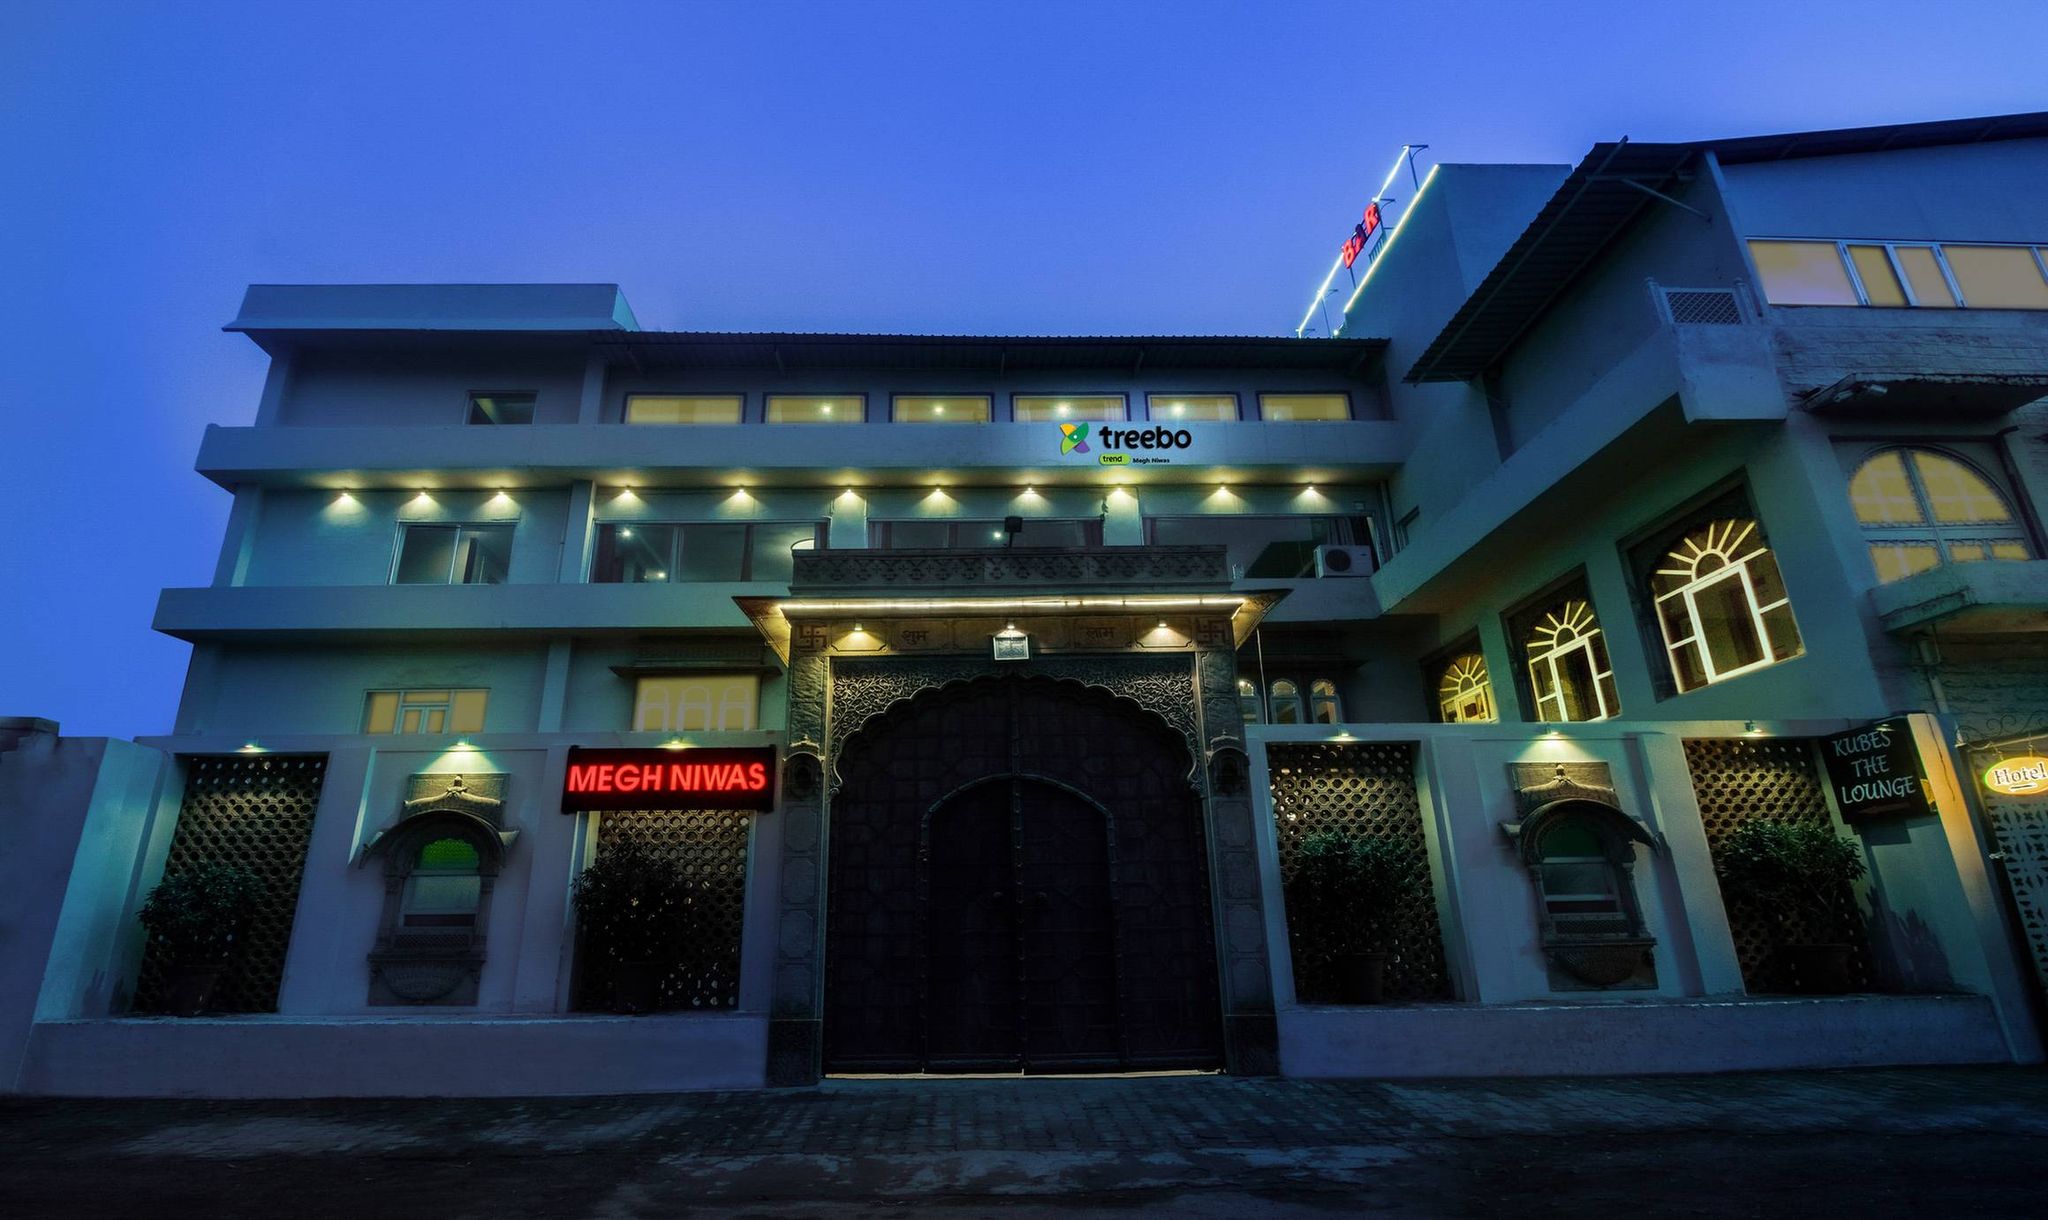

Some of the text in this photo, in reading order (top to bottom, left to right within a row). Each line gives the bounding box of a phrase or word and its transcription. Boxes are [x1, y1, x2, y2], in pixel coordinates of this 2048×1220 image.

[1098, 426, 1192, 449] treebo
[1102, 455, 1123, 463] trend
[1832, 731, 1891, 757] KUBES
[568, 763, 767, 792] MEGH NIWAS
[1850, 754, 1890, 778] THE
[1993, 762, 2048, 785] Hotel
[1841, 775, 1917, 804] LOUNGE
